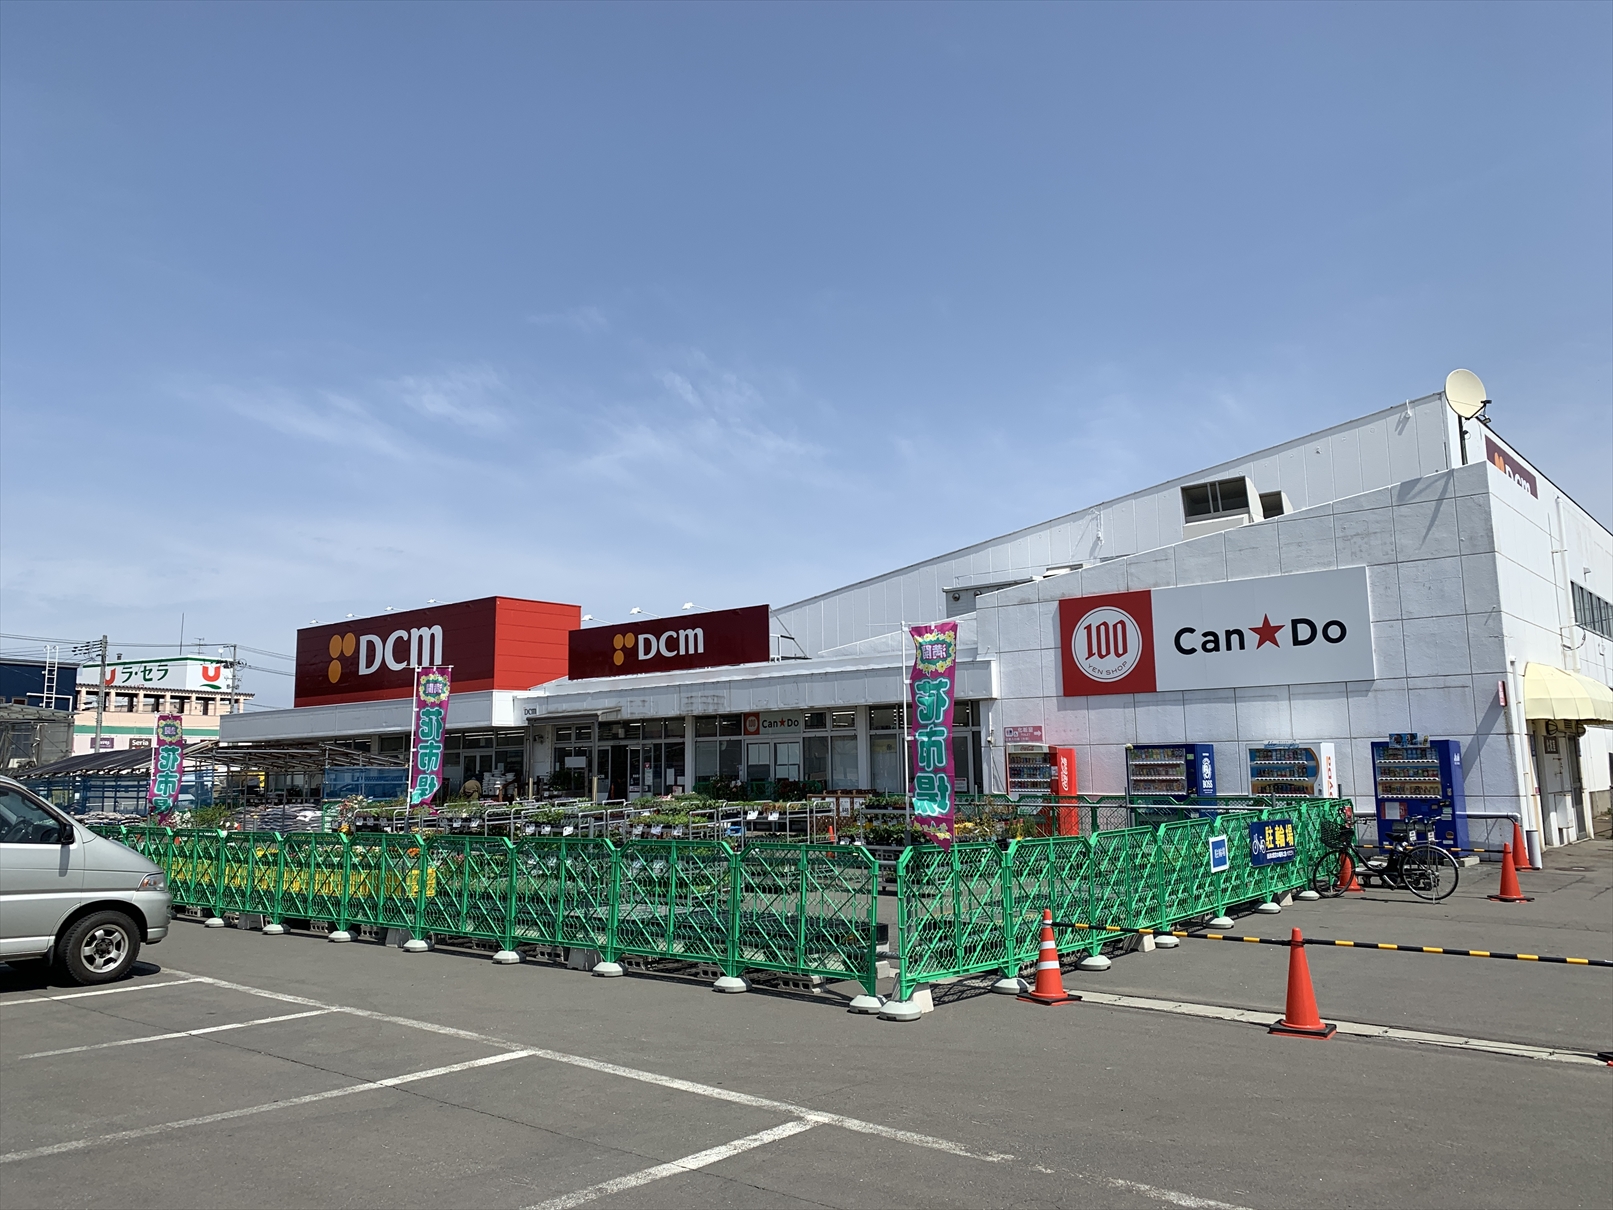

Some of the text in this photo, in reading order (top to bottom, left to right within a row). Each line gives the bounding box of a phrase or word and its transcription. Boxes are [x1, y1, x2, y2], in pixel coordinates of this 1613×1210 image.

[1083, 619, 1129, 662] 100
[1174, 617, 1348, 656] Can Do
[121, 664, 169, 683] ラ・セラ
[1087, 660, 1129, 676] YEN SHOP
[761, 718, 800, 729] Can Do
[1202, 780, 1213, 789] BOSS
[1265, 824, 1294, 849] 駐輪場
